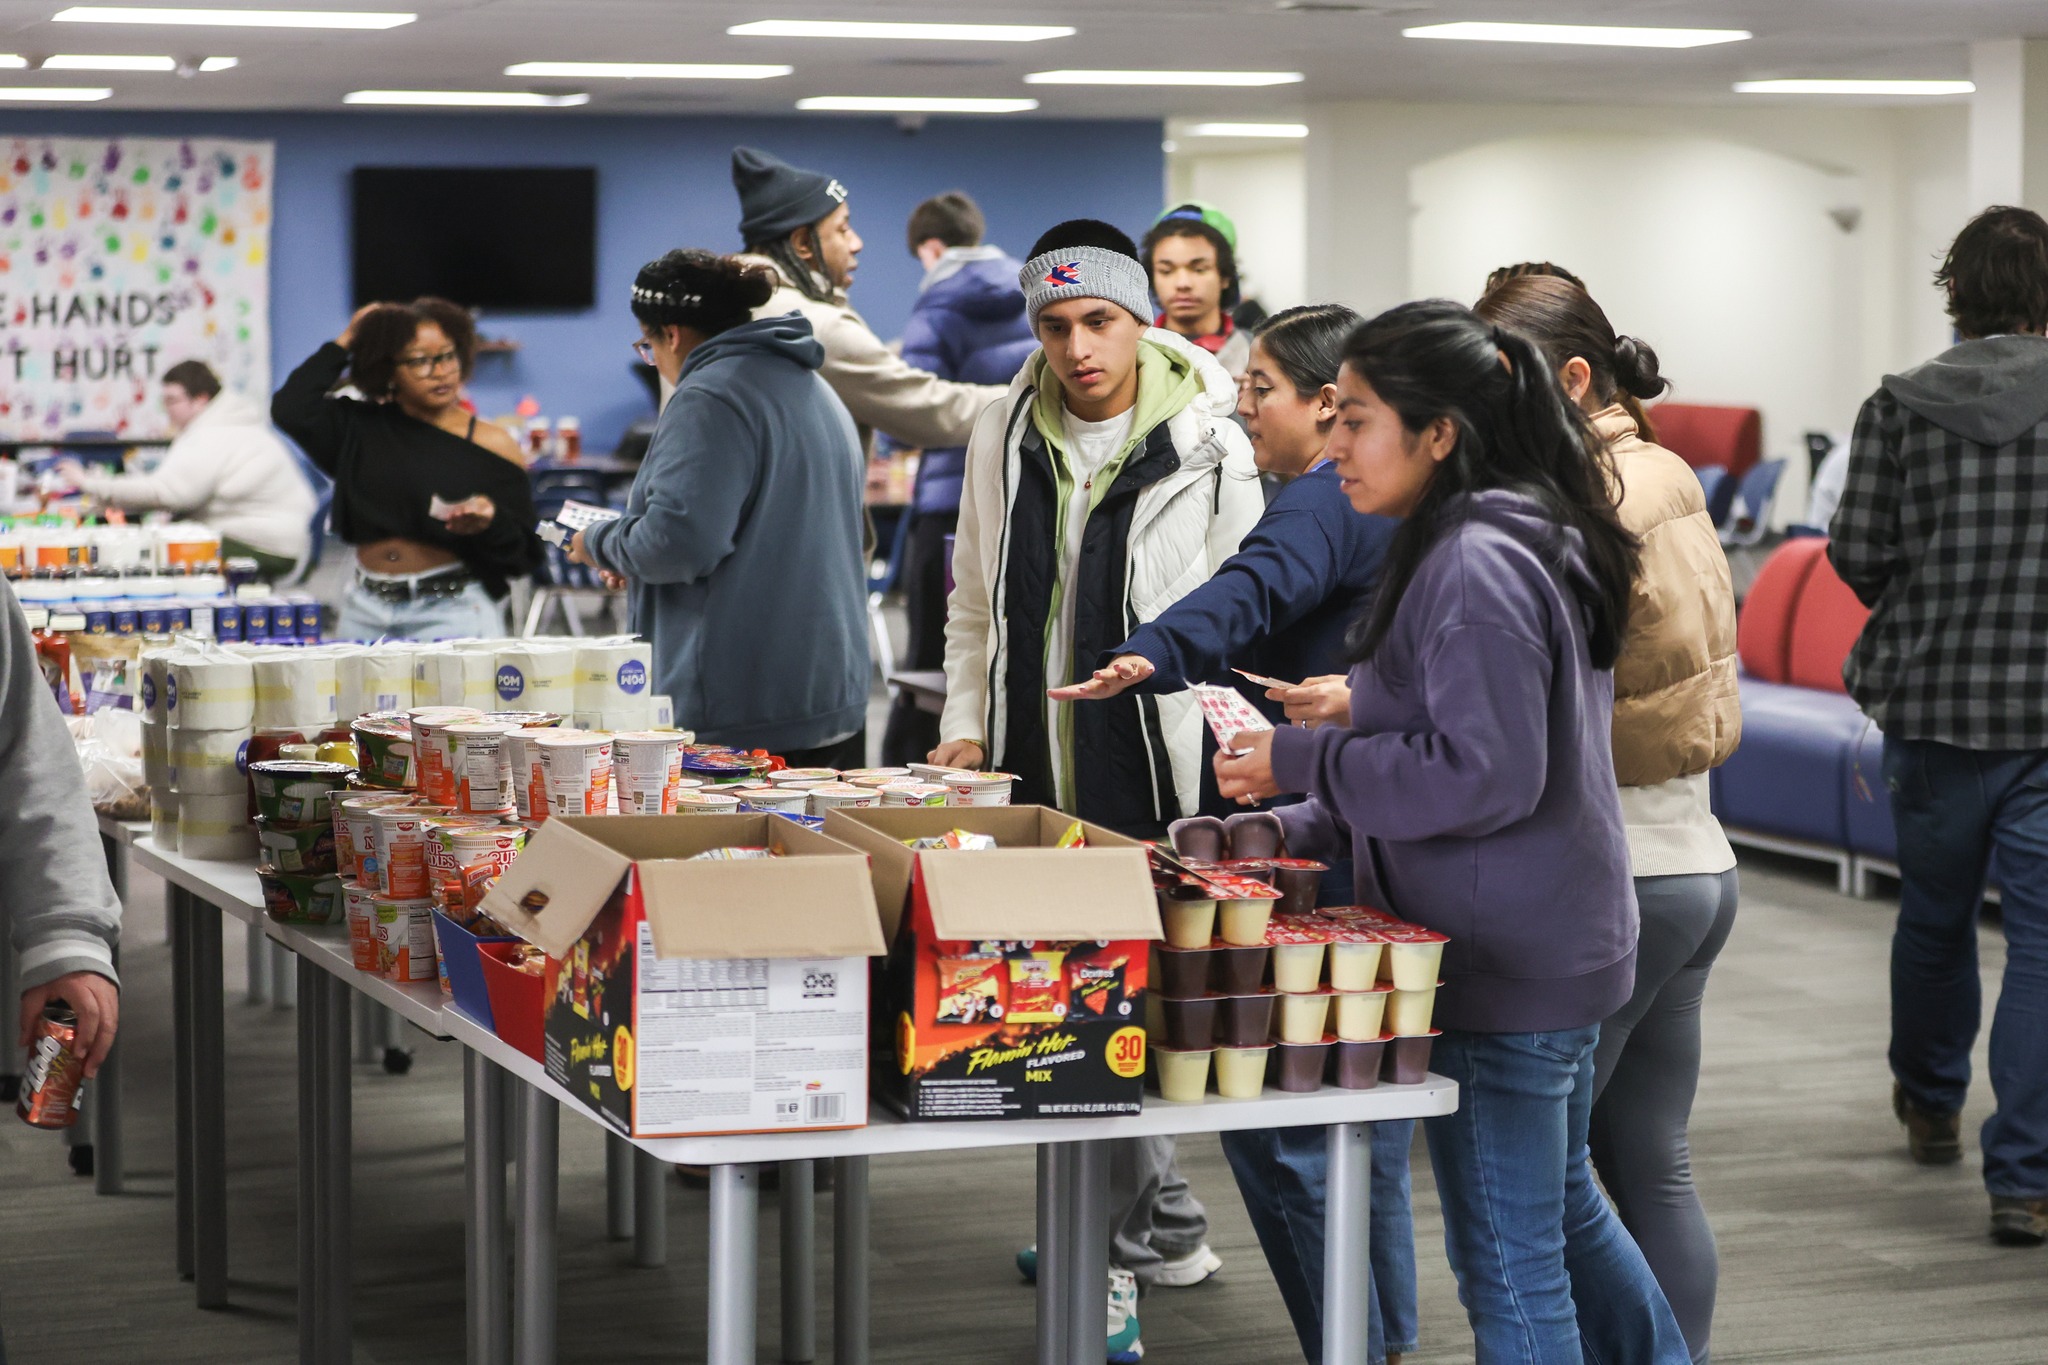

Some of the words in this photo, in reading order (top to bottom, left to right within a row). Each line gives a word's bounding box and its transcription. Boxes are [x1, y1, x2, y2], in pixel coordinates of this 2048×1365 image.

[32, 290, 176, 328] HANDS
[53, 343, 160, 381] HURT
[497, 674, 520, 687] POM
[620, 674, 645, 686] POM
[427, 842, 444, 855] UP
[470, 866, 493, 881] Lance
[1080, 968, 1115, 978] Doritos
[1037, 1032, 1077, 1055] Hot
[1115, 1035, 1142, 1062] 30
[1026, 1050, 1086, 1069] FLAVORED
[1025, 1070, 1052, 1082] MIX
